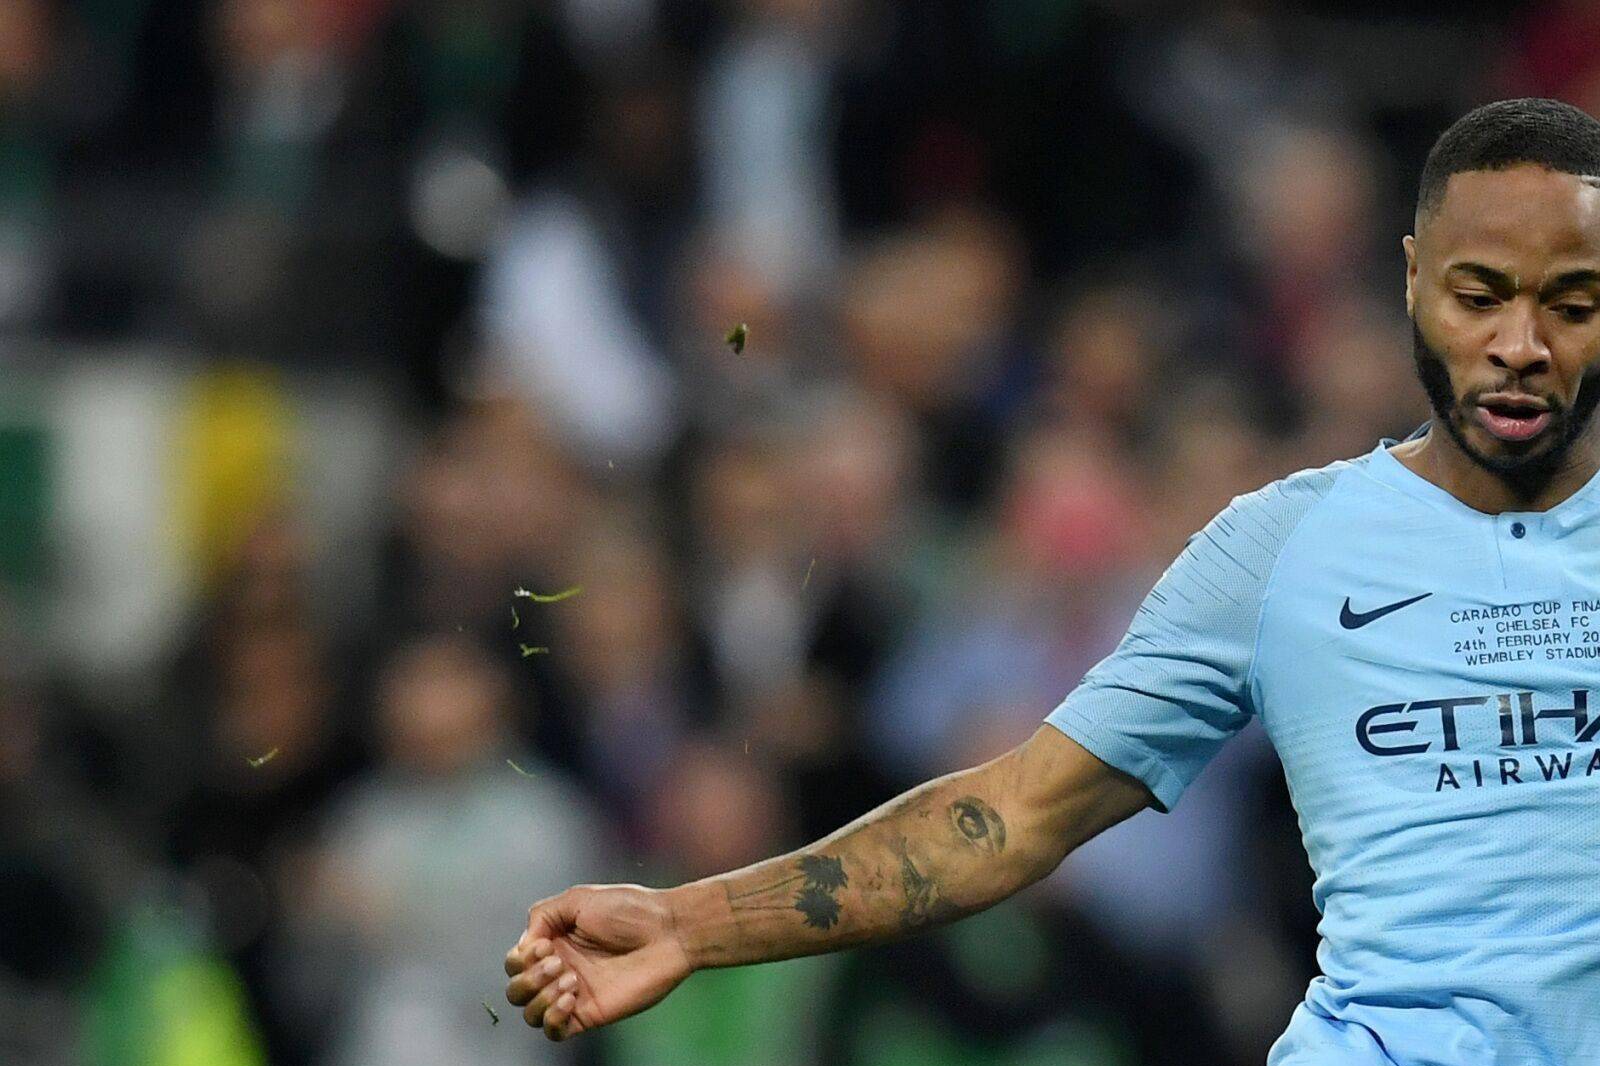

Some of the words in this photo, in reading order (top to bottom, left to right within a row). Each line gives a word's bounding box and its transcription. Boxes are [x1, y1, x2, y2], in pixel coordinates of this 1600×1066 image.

[1450, 604, 1522, 624] CARABAO
[1532, 601, 1561, 615] CUP
[1477, 626, 1484, 635] v
[1496, 618, 1561, 634] CHELSEA
[1571, 616, 1590, 628] FC
[1454, 639, 1487, 653] 24th
[1497, 632, 1570, 648] FEBRUARY
[1465, 650, 1534, 666] WEMBLEY
